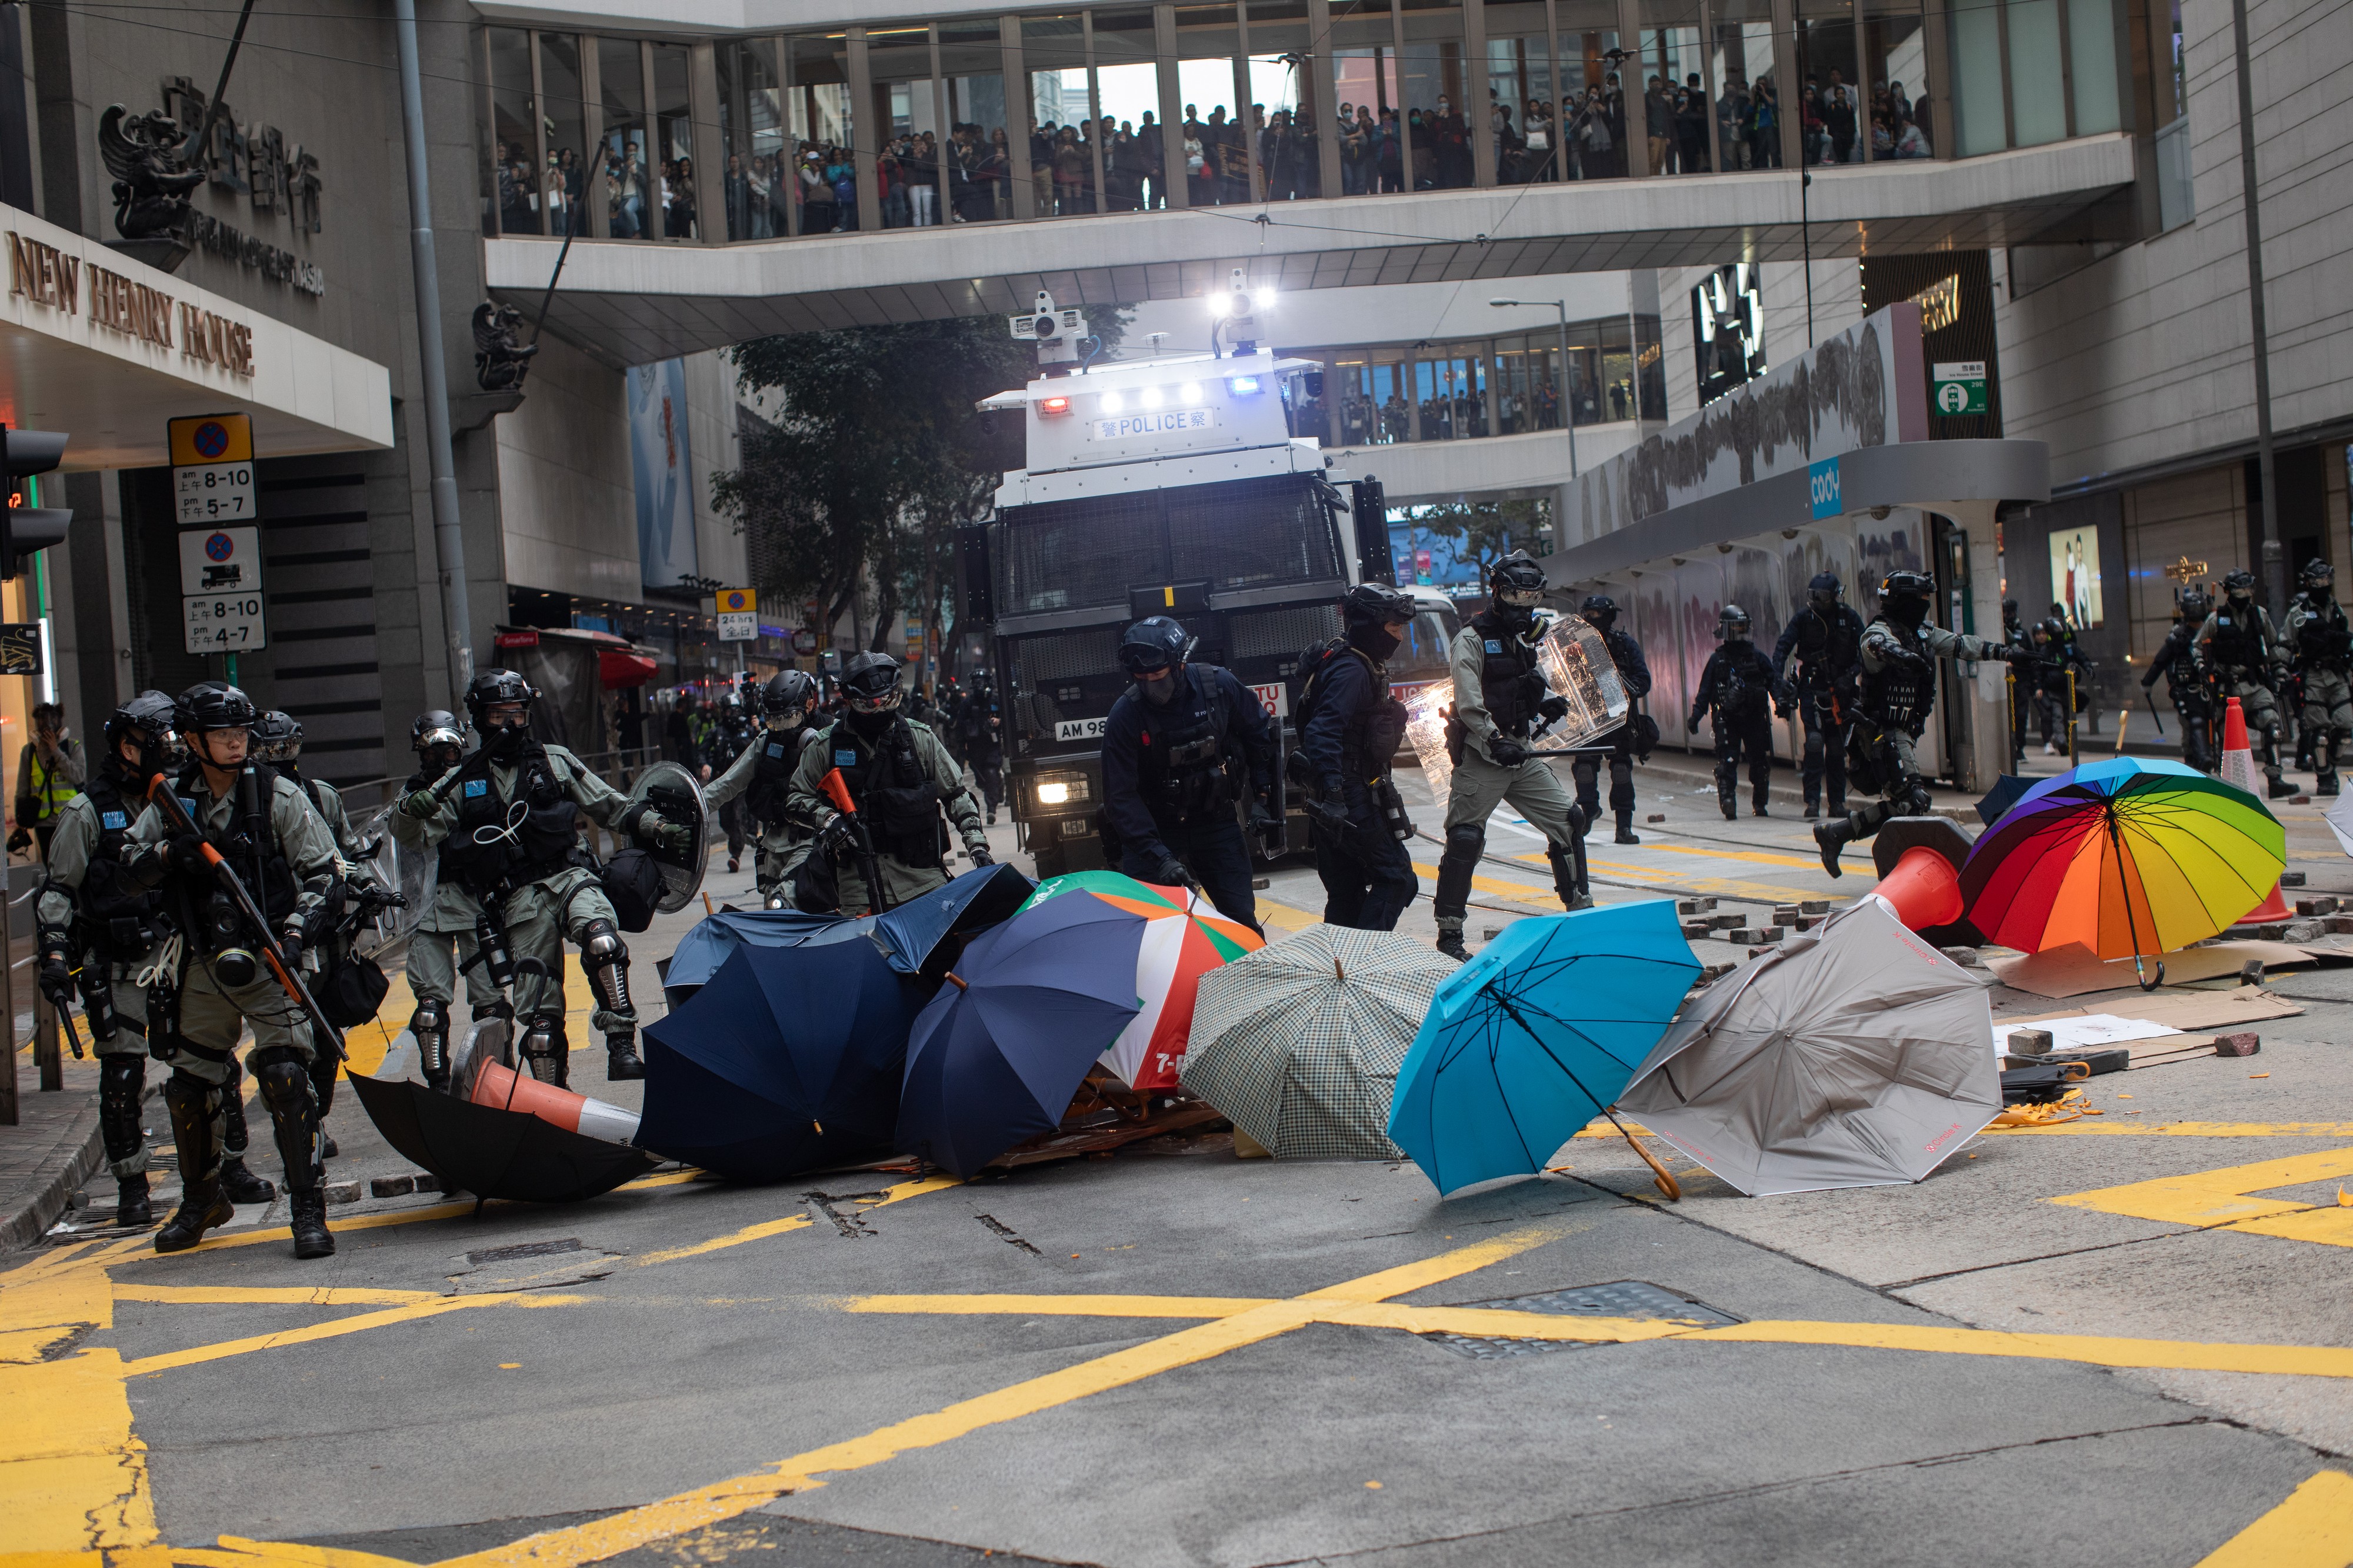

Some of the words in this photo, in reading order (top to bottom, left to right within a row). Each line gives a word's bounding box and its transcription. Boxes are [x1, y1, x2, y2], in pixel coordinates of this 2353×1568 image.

[299, 259, 325, 296] ASIA
[4, 230, 80, 315] NEW
[85, 262, 175, 349] HENRY
[178, 301, 255, 377] HOUSE
[1120, 412, 1187, 435] POLICE
[1190, 411, 1205, 426] 察
[1101, 421, 1117, 438] 警
[179, 481, 201, 492] 上午
[205, 469, 249, 488] 8-10
[1812, 466, 1839, 505] cody
[184, 498, 198, 506] pm
[180, 507, 204, 518] 下午
[189, 610, 212, 621] 上午
[214, 599, 259, 618] 8-10
[722, 615, 735, 623] 24
[193, 627, 208, 635] pm
[215, 626, 249, 642] 4-7
[726, 626, 749, 637] 全日
[190, 636, 213, 647] 下午
[1062, 723, 1082, 738] AM
[1902, 938, 1928, 958] Circle
[1932, 1129, 1956, 1146] Circle
[1675, 1136, 1704, 1156] Circle
